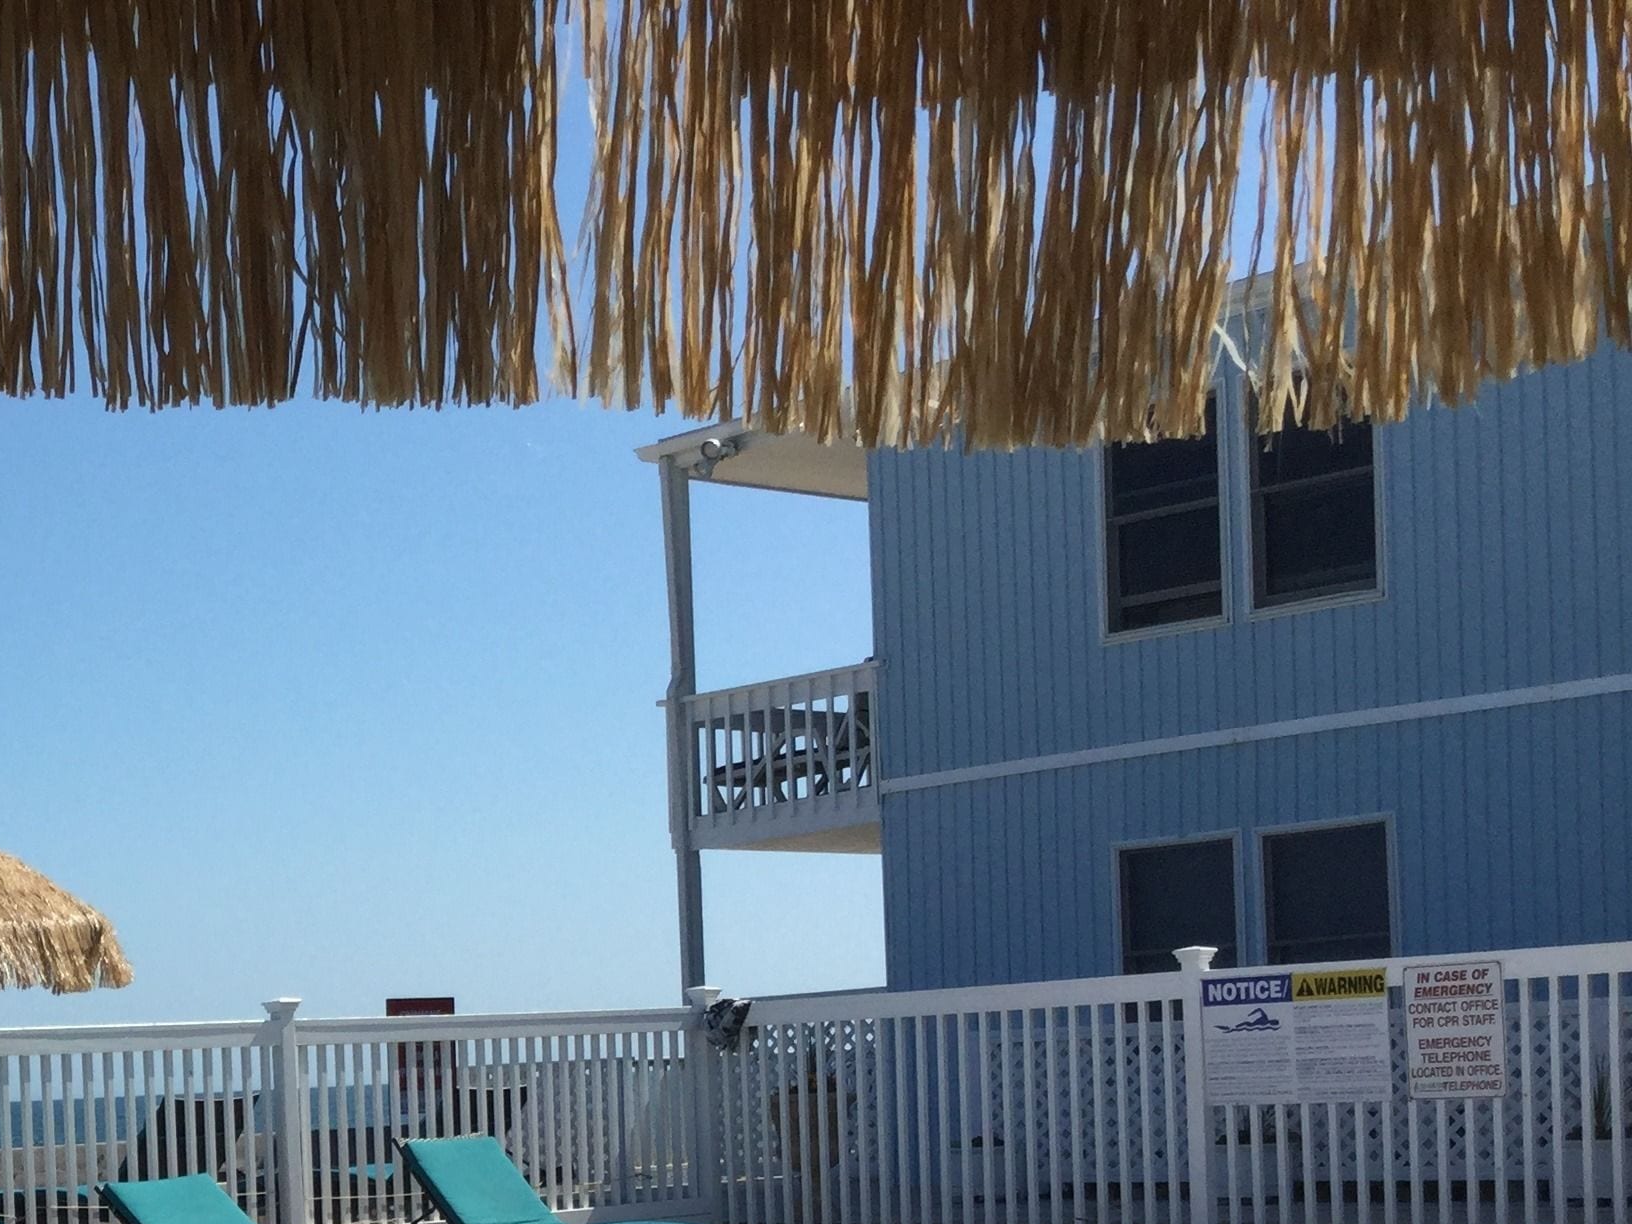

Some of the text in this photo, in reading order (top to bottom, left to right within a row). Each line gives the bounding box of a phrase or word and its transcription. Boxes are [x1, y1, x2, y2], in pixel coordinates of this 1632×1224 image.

[1417, 968, 1489, 984] IN CASE OF
[1314, 974, 1385, 997] WARNING
[1414, 983, 1493, 998] EMERGENCY
[1408, 999, 1499, 1015] CONTACT OFFICE
[1413, 1017, 1434, 1028] FOR
[1437, 1015, 1459, 1027] CPR
[1418, 1036, 1492, 1049] EMERGENCY
[1421, 1050, 1491, 1063] TELEPHONE
[1411, 1066, 1453, 1078] LOCATED
[1456, 1065, 1465, 1077] IN
